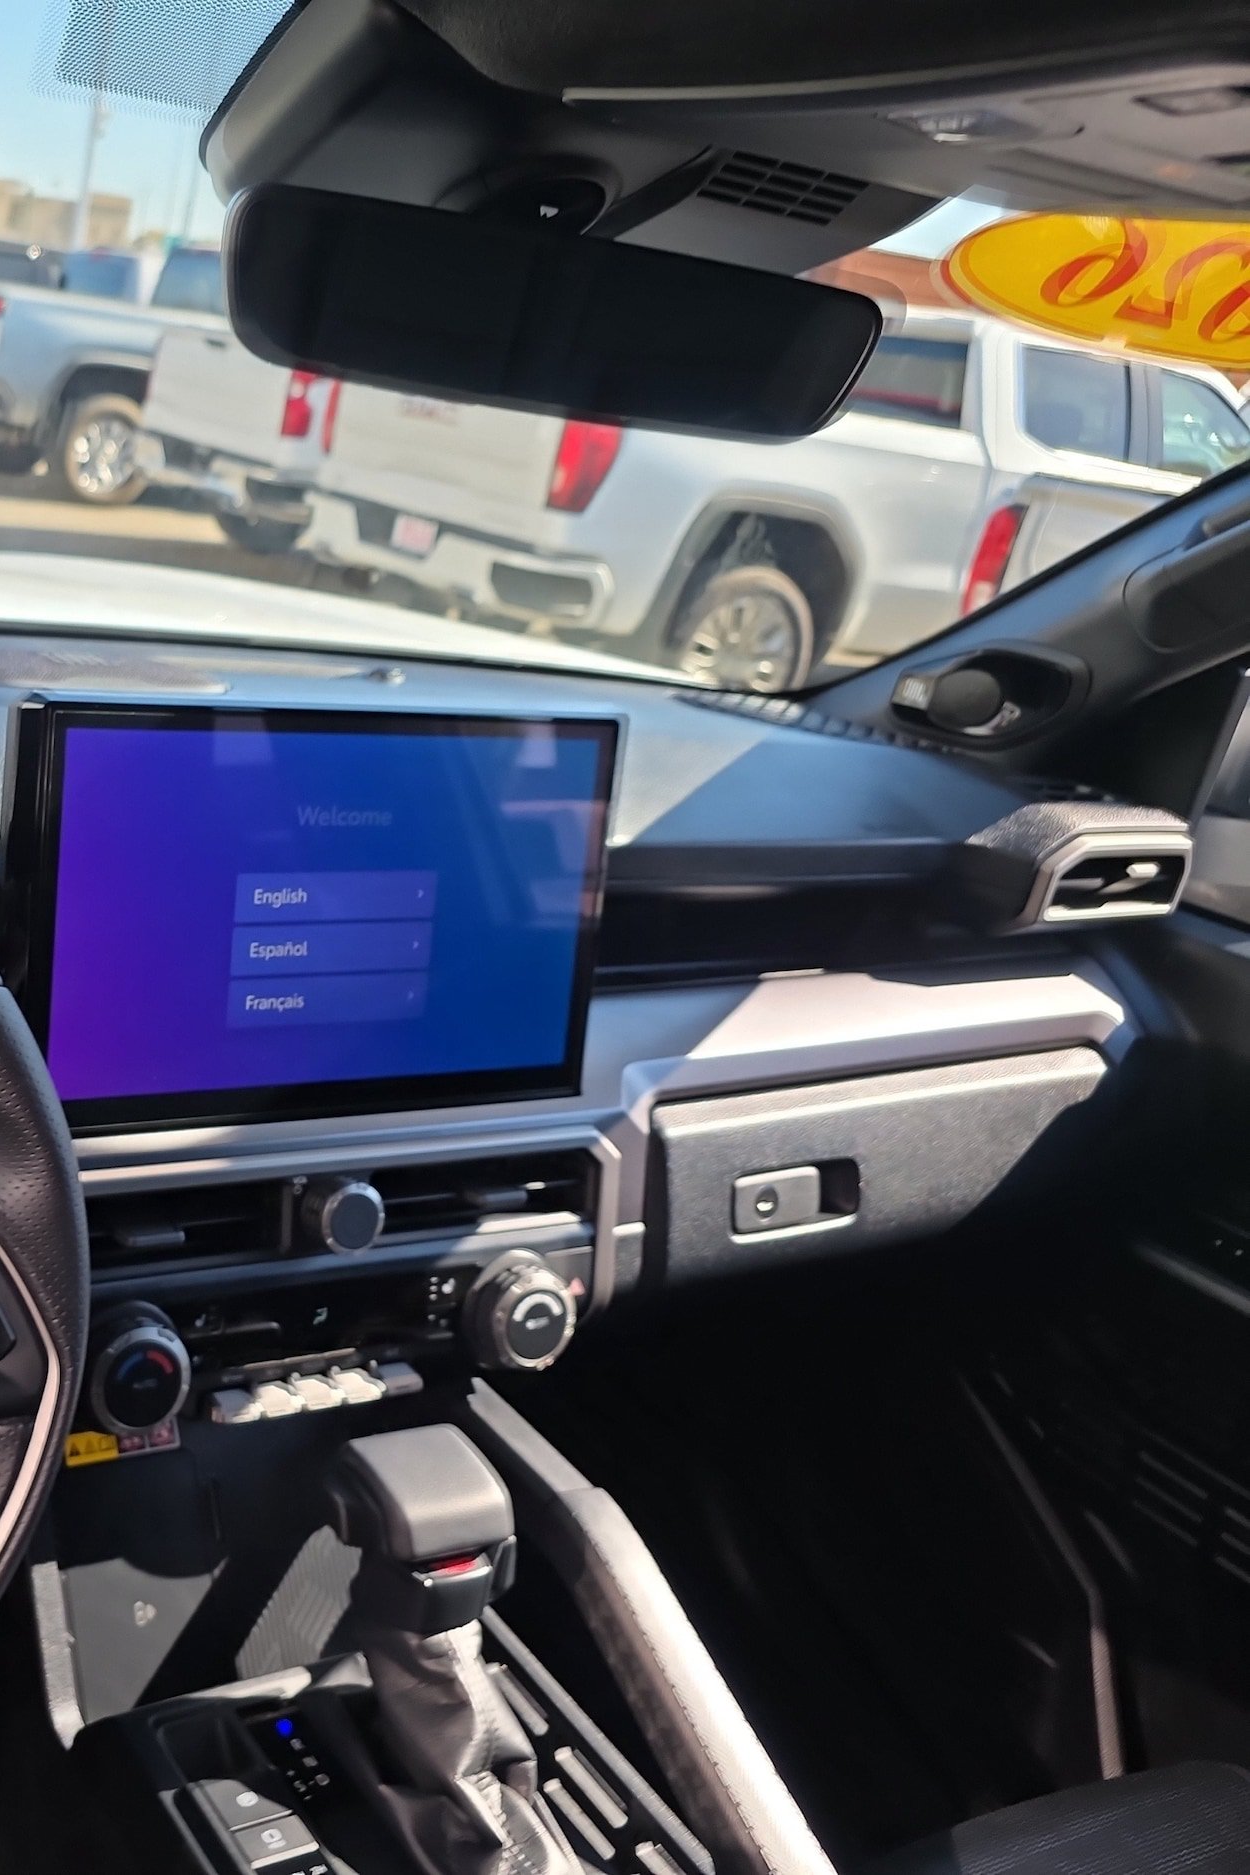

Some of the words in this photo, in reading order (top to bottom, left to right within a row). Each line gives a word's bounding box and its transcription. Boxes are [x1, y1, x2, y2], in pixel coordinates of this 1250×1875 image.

[297, 804, 393, 827] Welcome
[253, 887, 308, 909] English
[249, 940, 308, 961] Español
[245, 992, 305, 1012] Français
